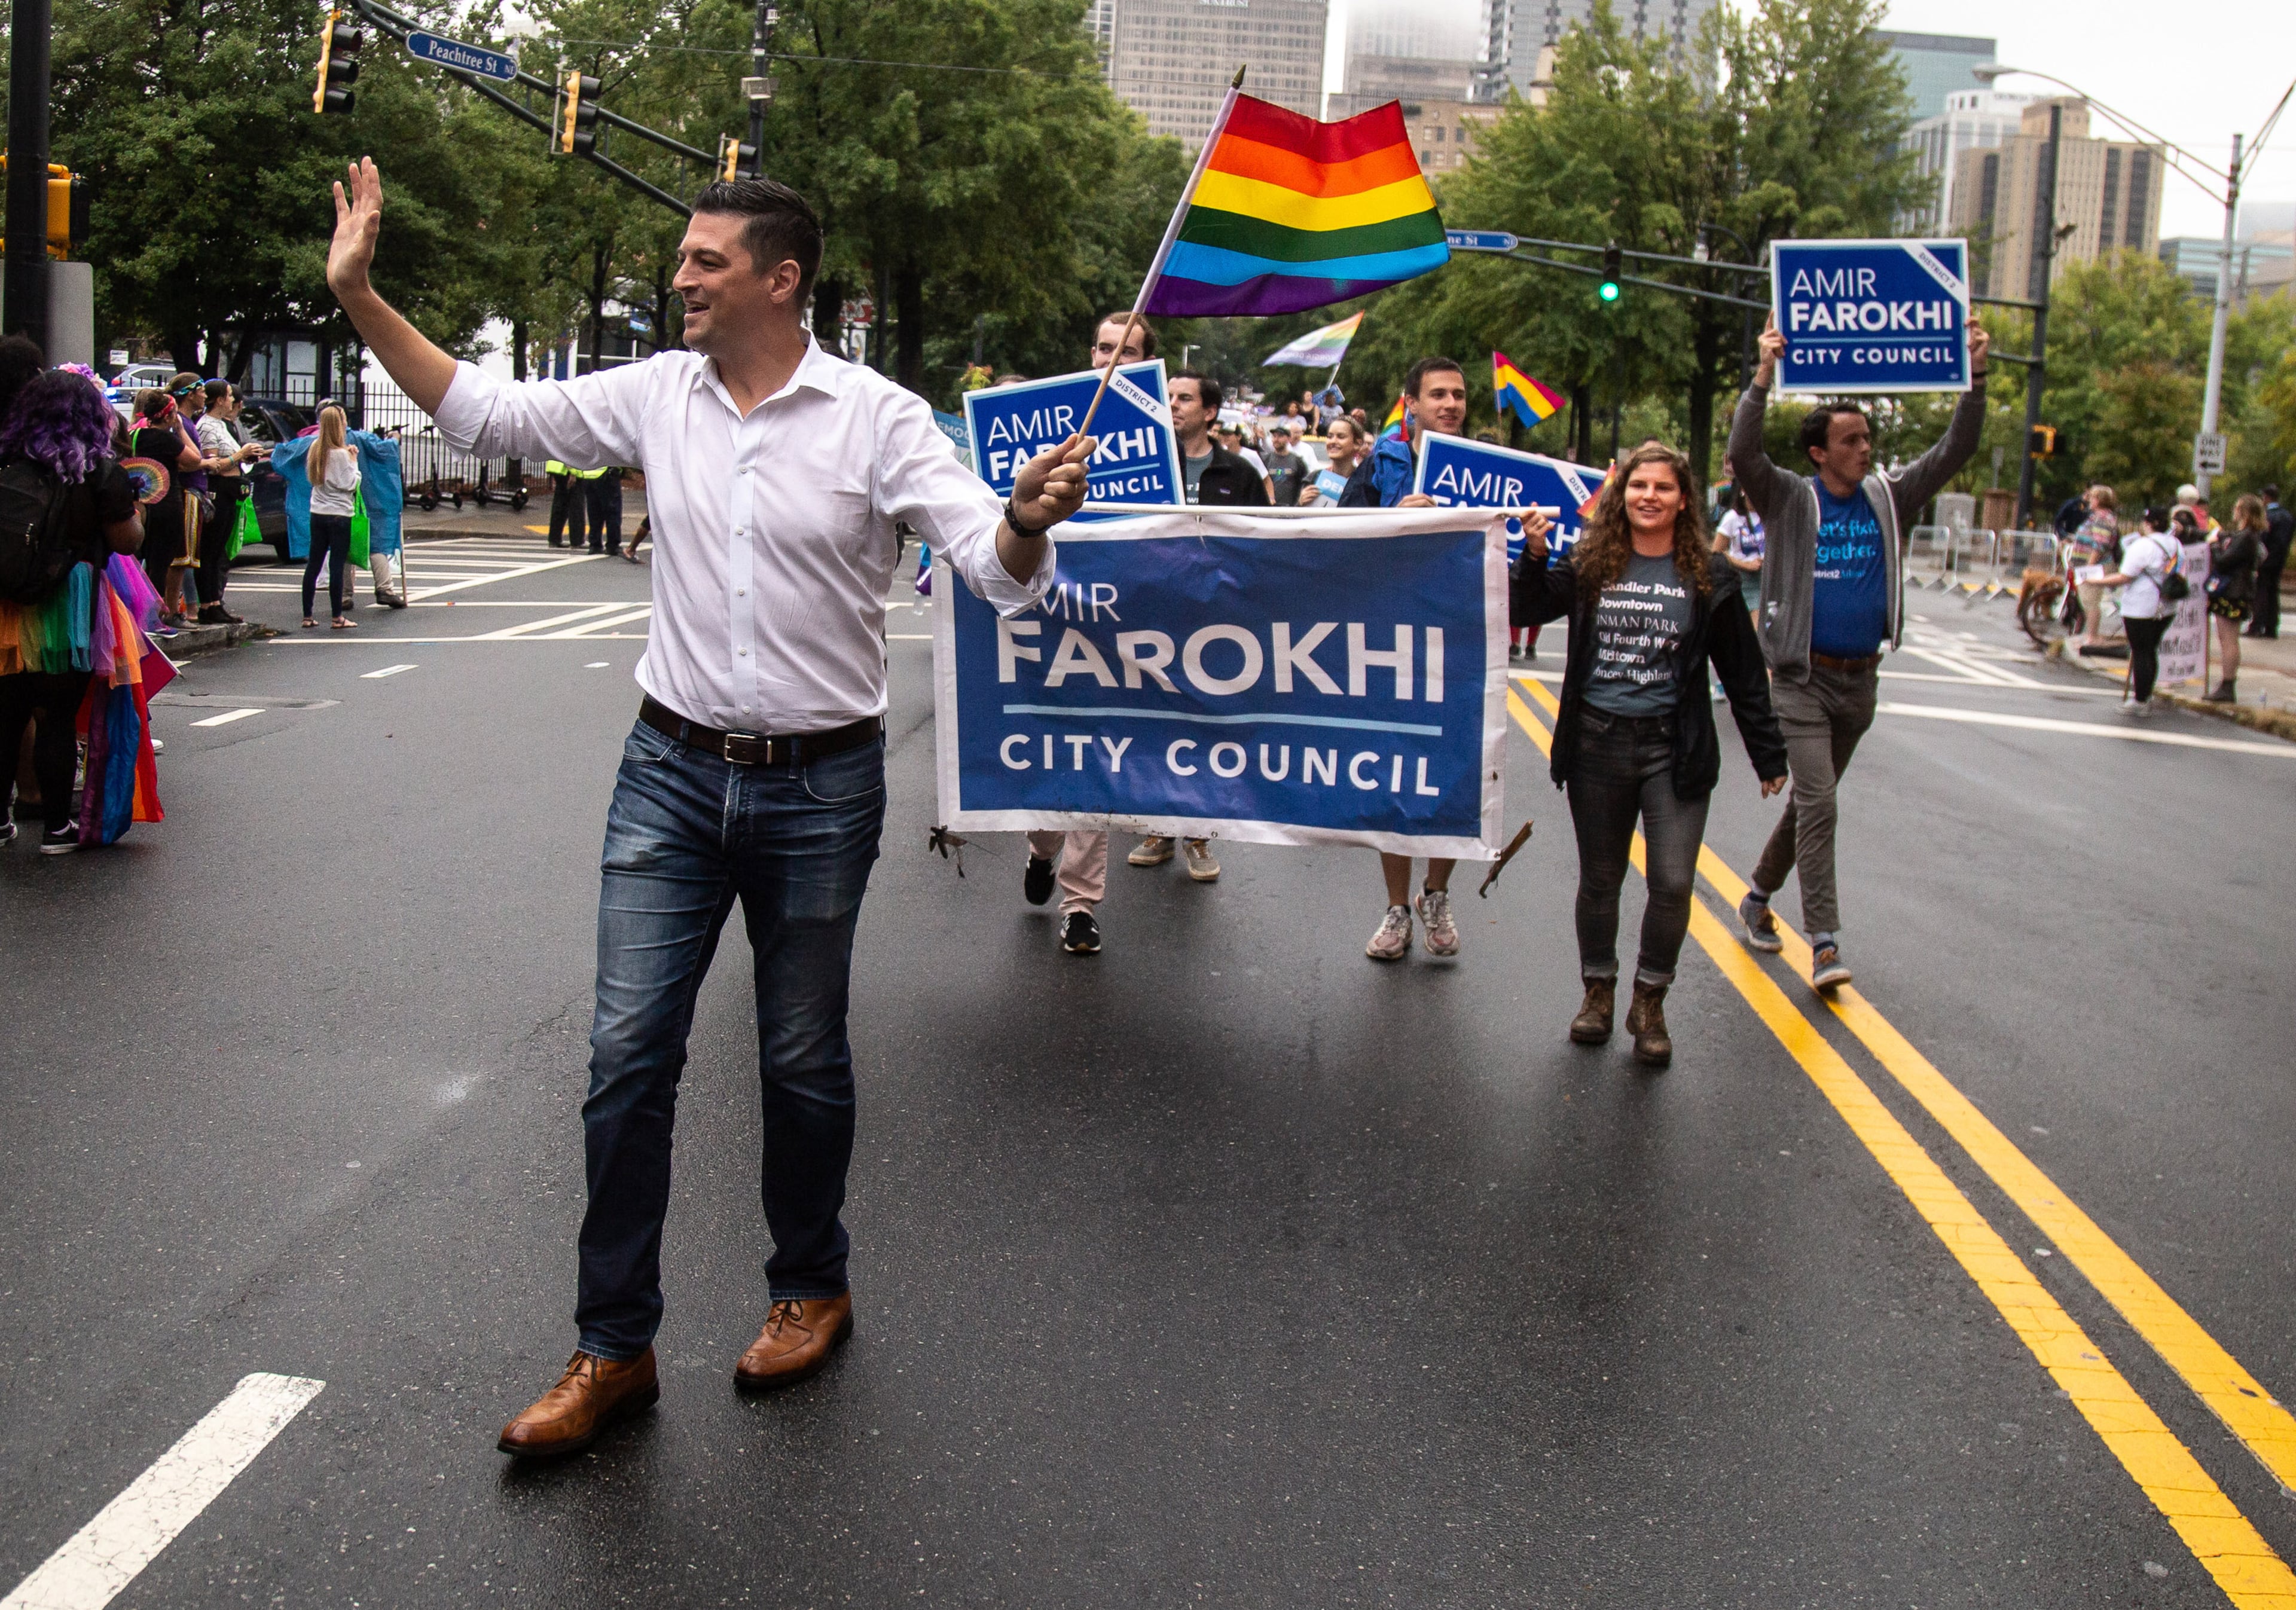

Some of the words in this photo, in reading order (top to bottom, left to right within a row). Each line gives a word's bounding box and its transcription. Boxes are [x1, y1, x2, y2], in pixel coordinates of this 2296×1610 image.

[429, 40, 483, 68] Peachtree
[486, 56, 497, 73] St
[504, 63, 515, 75] NE
[1447, 236, 1462, 244] ne
[1465, 234, 1477, 246] St
[1918, 252, 1950, 283] DISTRICT
[1790, 268, 1877, 297] AMIR
[1790, 301, 1952, 331] FAROKHI
[1792, 349, 1842, 365] CITY
[1852, 347, 1954, 364] COUNCIL
[1116, 379, 1152, 407] DISTRICT
[987, 405, 1077, 447] AMIR
[989, 426, 1158, 481] FAKHI
[2202, 437, 2219, 447] ONE
[1083, 475, 1164, 502] UNCIL
[1433, 464, 1523, 507] AMIR
[1569, 476, 1587, 501] DISTR
[1818, 521, 1847, 537] et's
[1042, 582, 1122, 623] MIR
[1654, 583, 1686, 598] Park
[1597, 614, 1640, 628] INMAN
[1644, 616, 1679, 633] PARK
[1614, 633, 1651, 647] Fourth
[996, 616, 1444, 702] FAROKHI
[1000, 734, 1134, 772] CITY
[1167, 738, 1440, 796] COUNCIL
